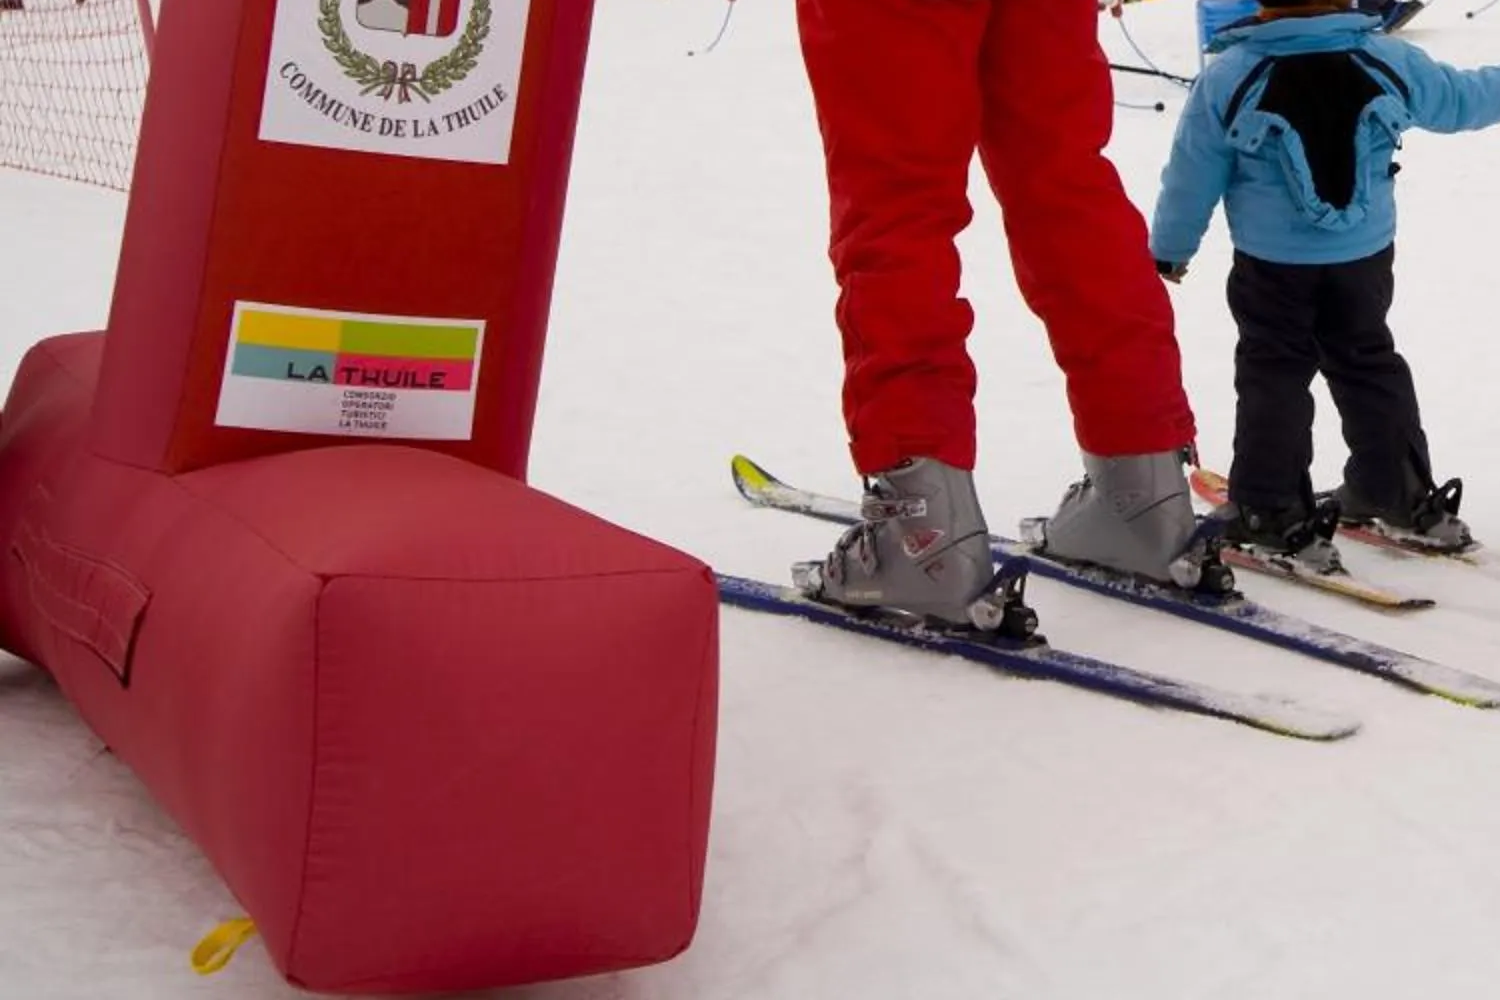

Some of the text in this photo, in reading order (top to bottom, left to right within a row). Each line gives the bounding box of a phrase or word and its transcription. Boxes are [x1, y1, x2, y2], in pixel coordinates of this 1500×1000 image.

[279, 60, 508, 138] COMMUNE DE LA THUILE
[286, 362, 447, 388] LA THUILE
